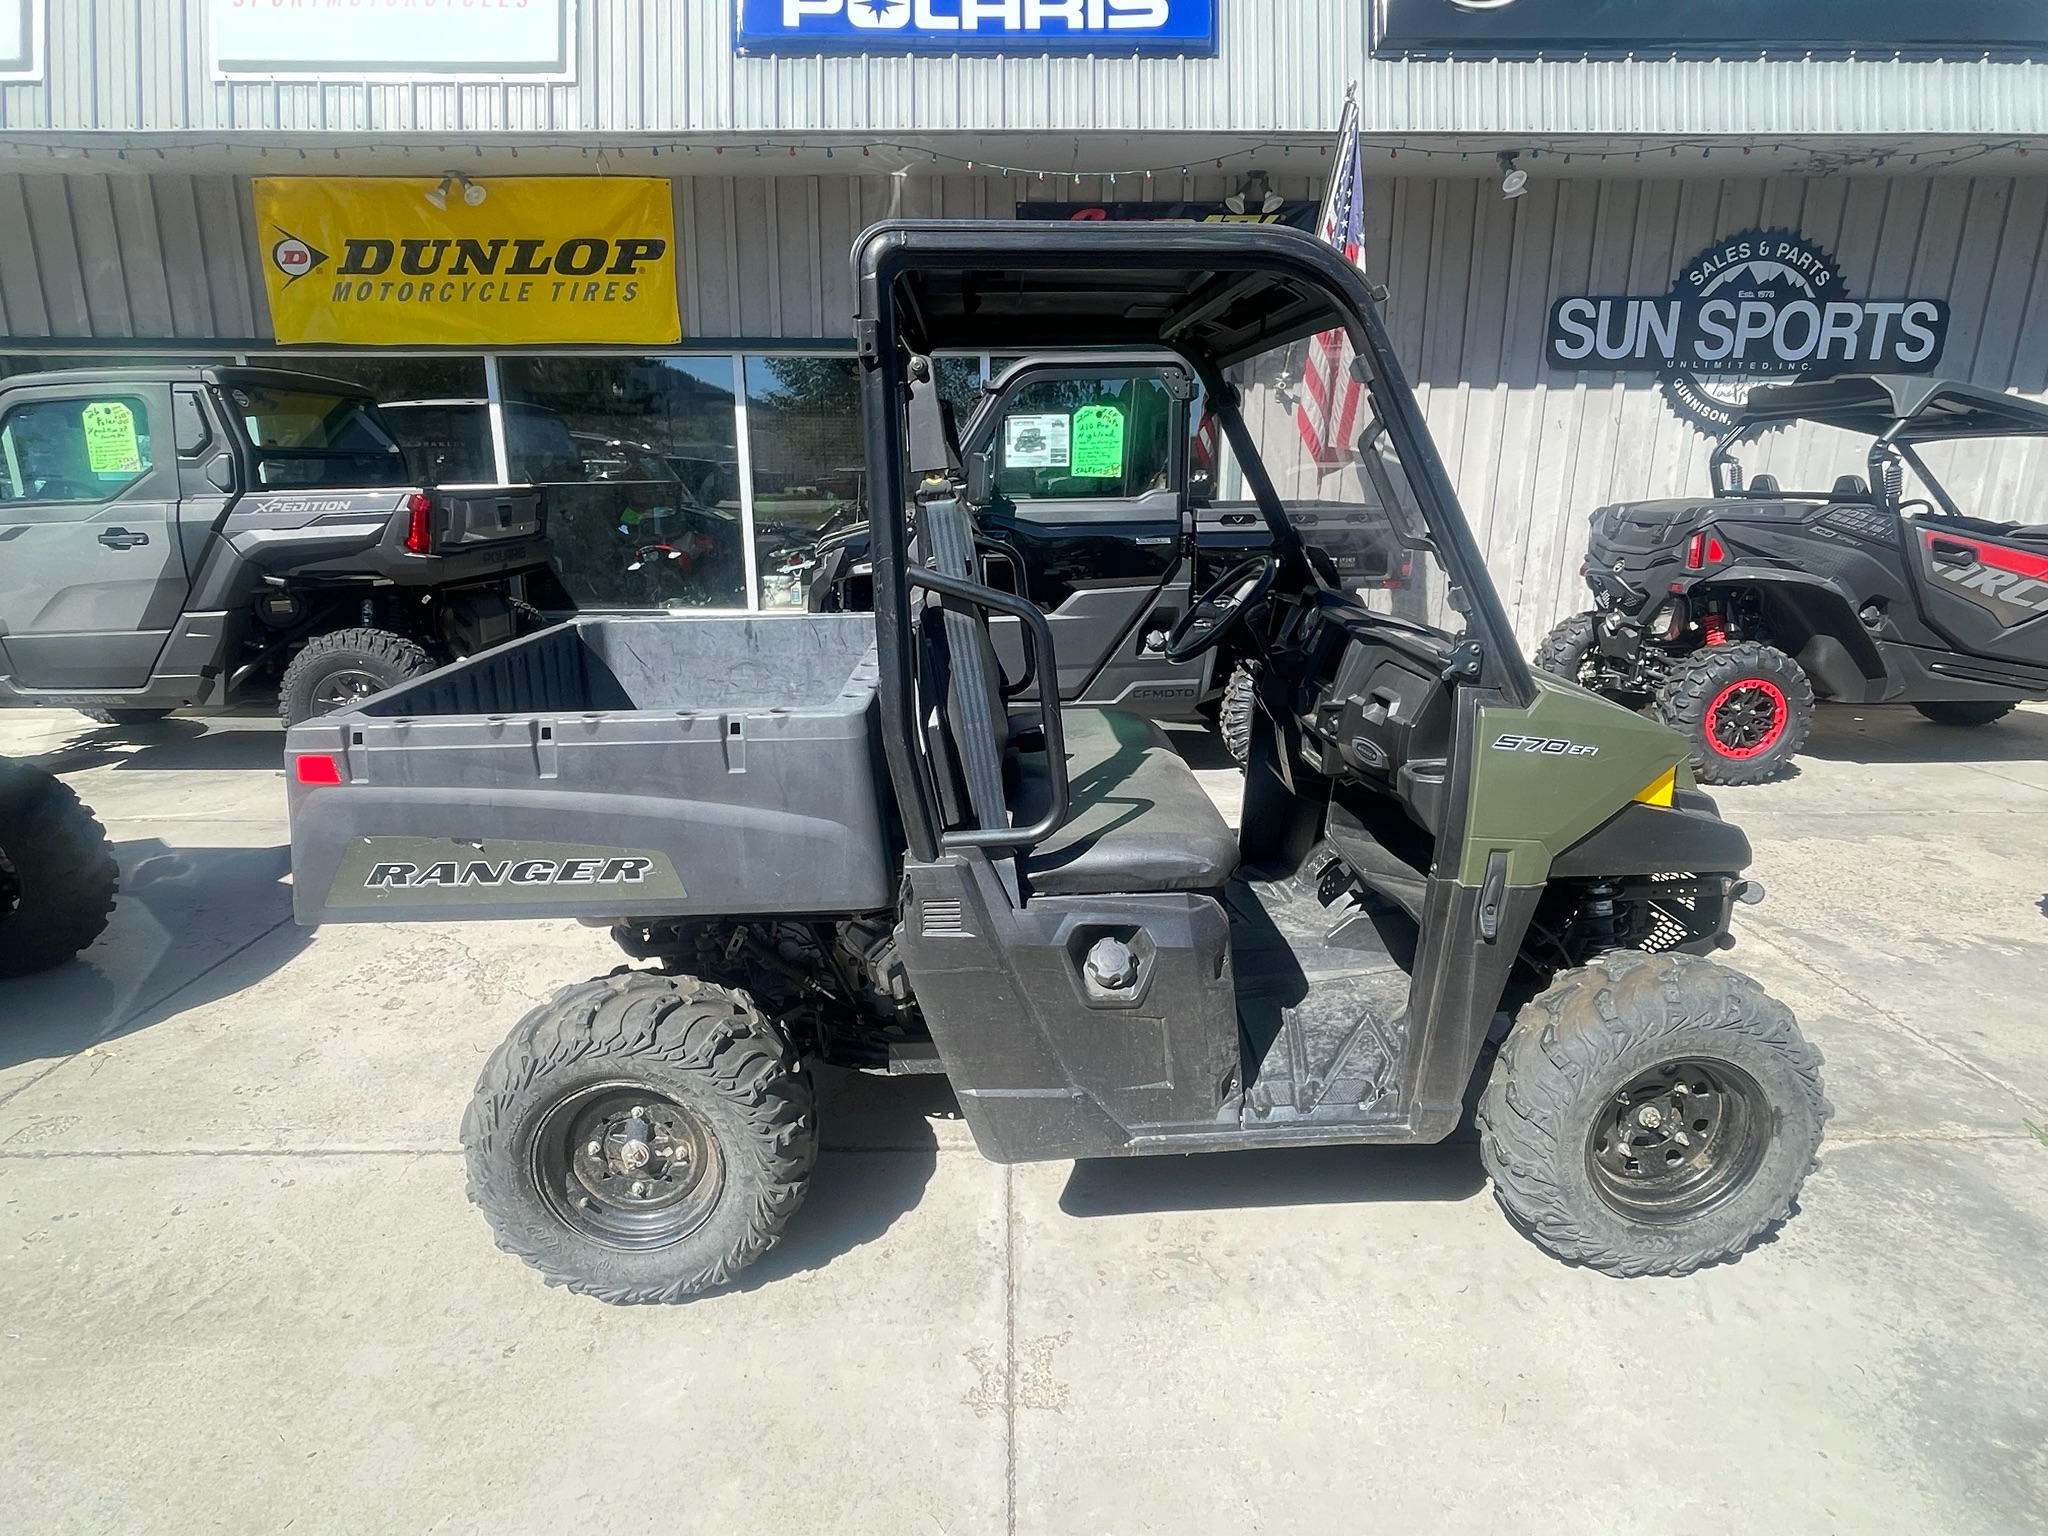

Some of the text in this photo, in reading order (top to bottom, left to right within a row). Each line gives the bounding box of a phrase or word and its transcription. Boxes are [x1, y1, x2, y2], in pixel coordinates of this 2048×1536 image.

[783, 0, 1169, 29] POLARIS
[336, 239, 666, 275] DUNLOP
[1689, 241, 1831, 286] SALES & PARTS
[333, 281, 638, 302] MOTORCYCLE TIRES
[1555, 298, 1939, 363] SUN SPORTS
[254, 499, 352, 512] XPEDITION
[48, 696, 126, 704] POLARIS
[1132, 688, 1194, 699] CFMOTO
[1492, 734, 1600, 756] 570 EFI
[363, 857, 652, 888] RANGER
